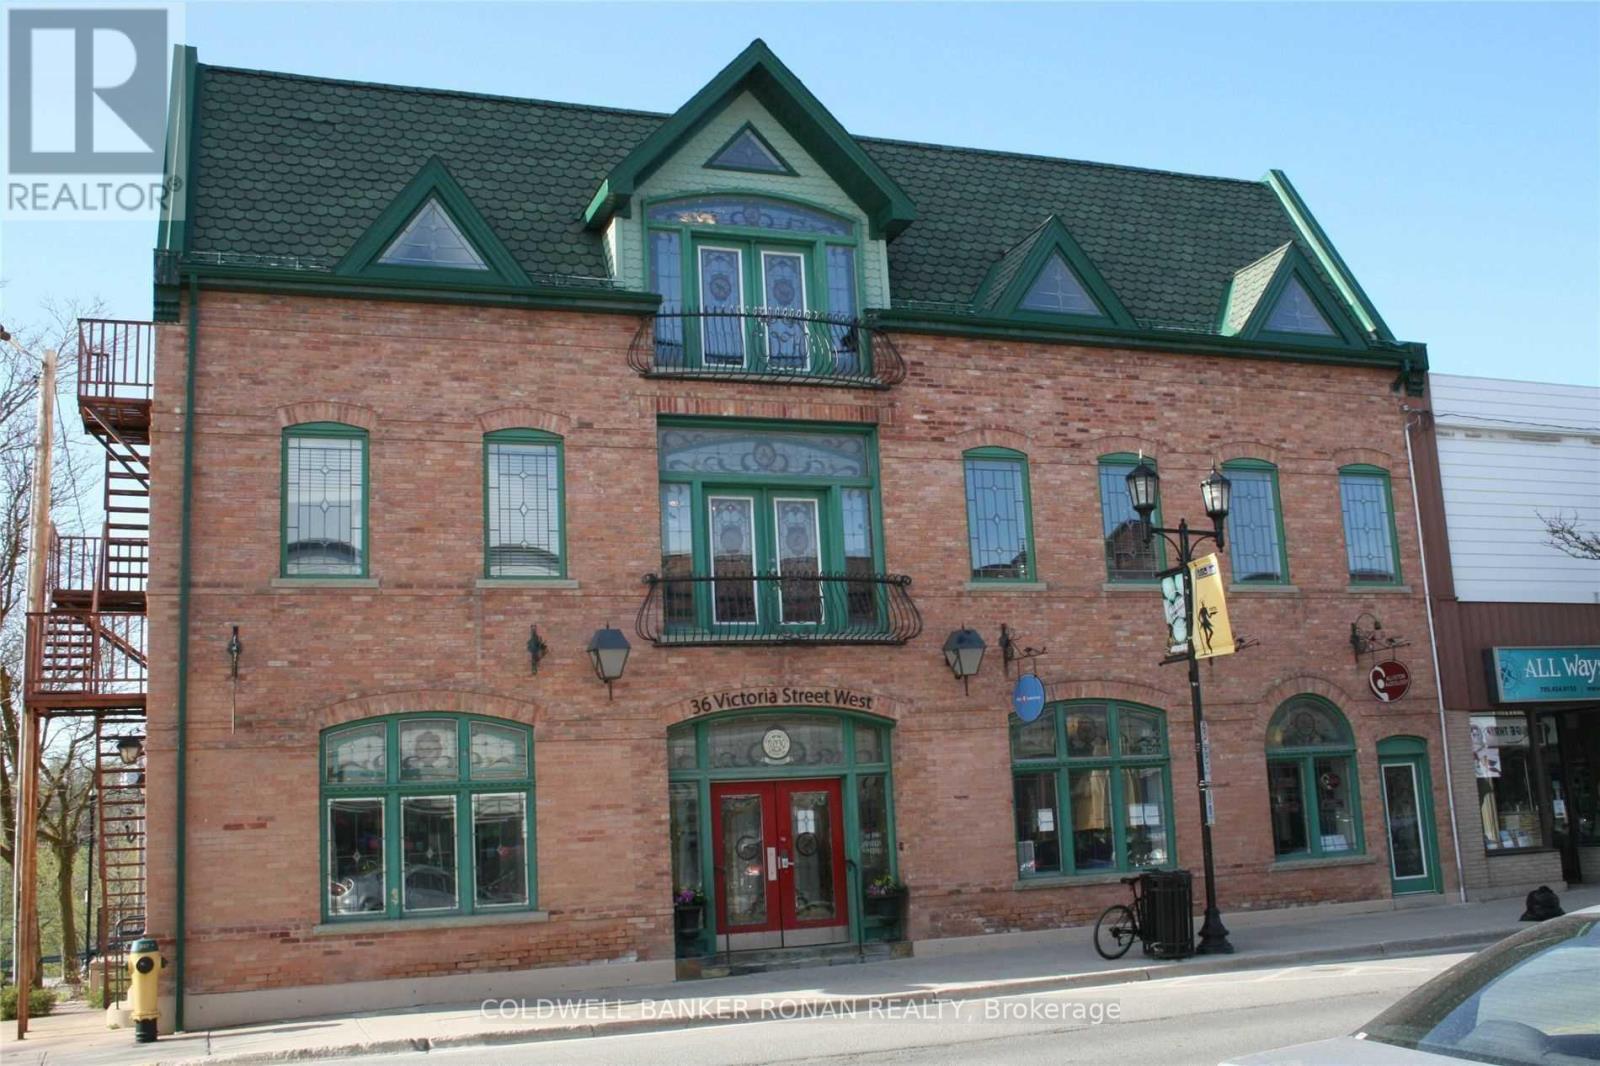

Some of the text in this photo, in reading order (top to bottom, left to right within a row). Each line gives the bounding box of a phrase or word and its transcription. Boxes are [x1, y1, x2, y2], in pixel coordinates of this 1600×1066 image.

[1524, 653, 1600, 684] ALL Way
[690, 687, 873, 715] 36 Victoria Street West
